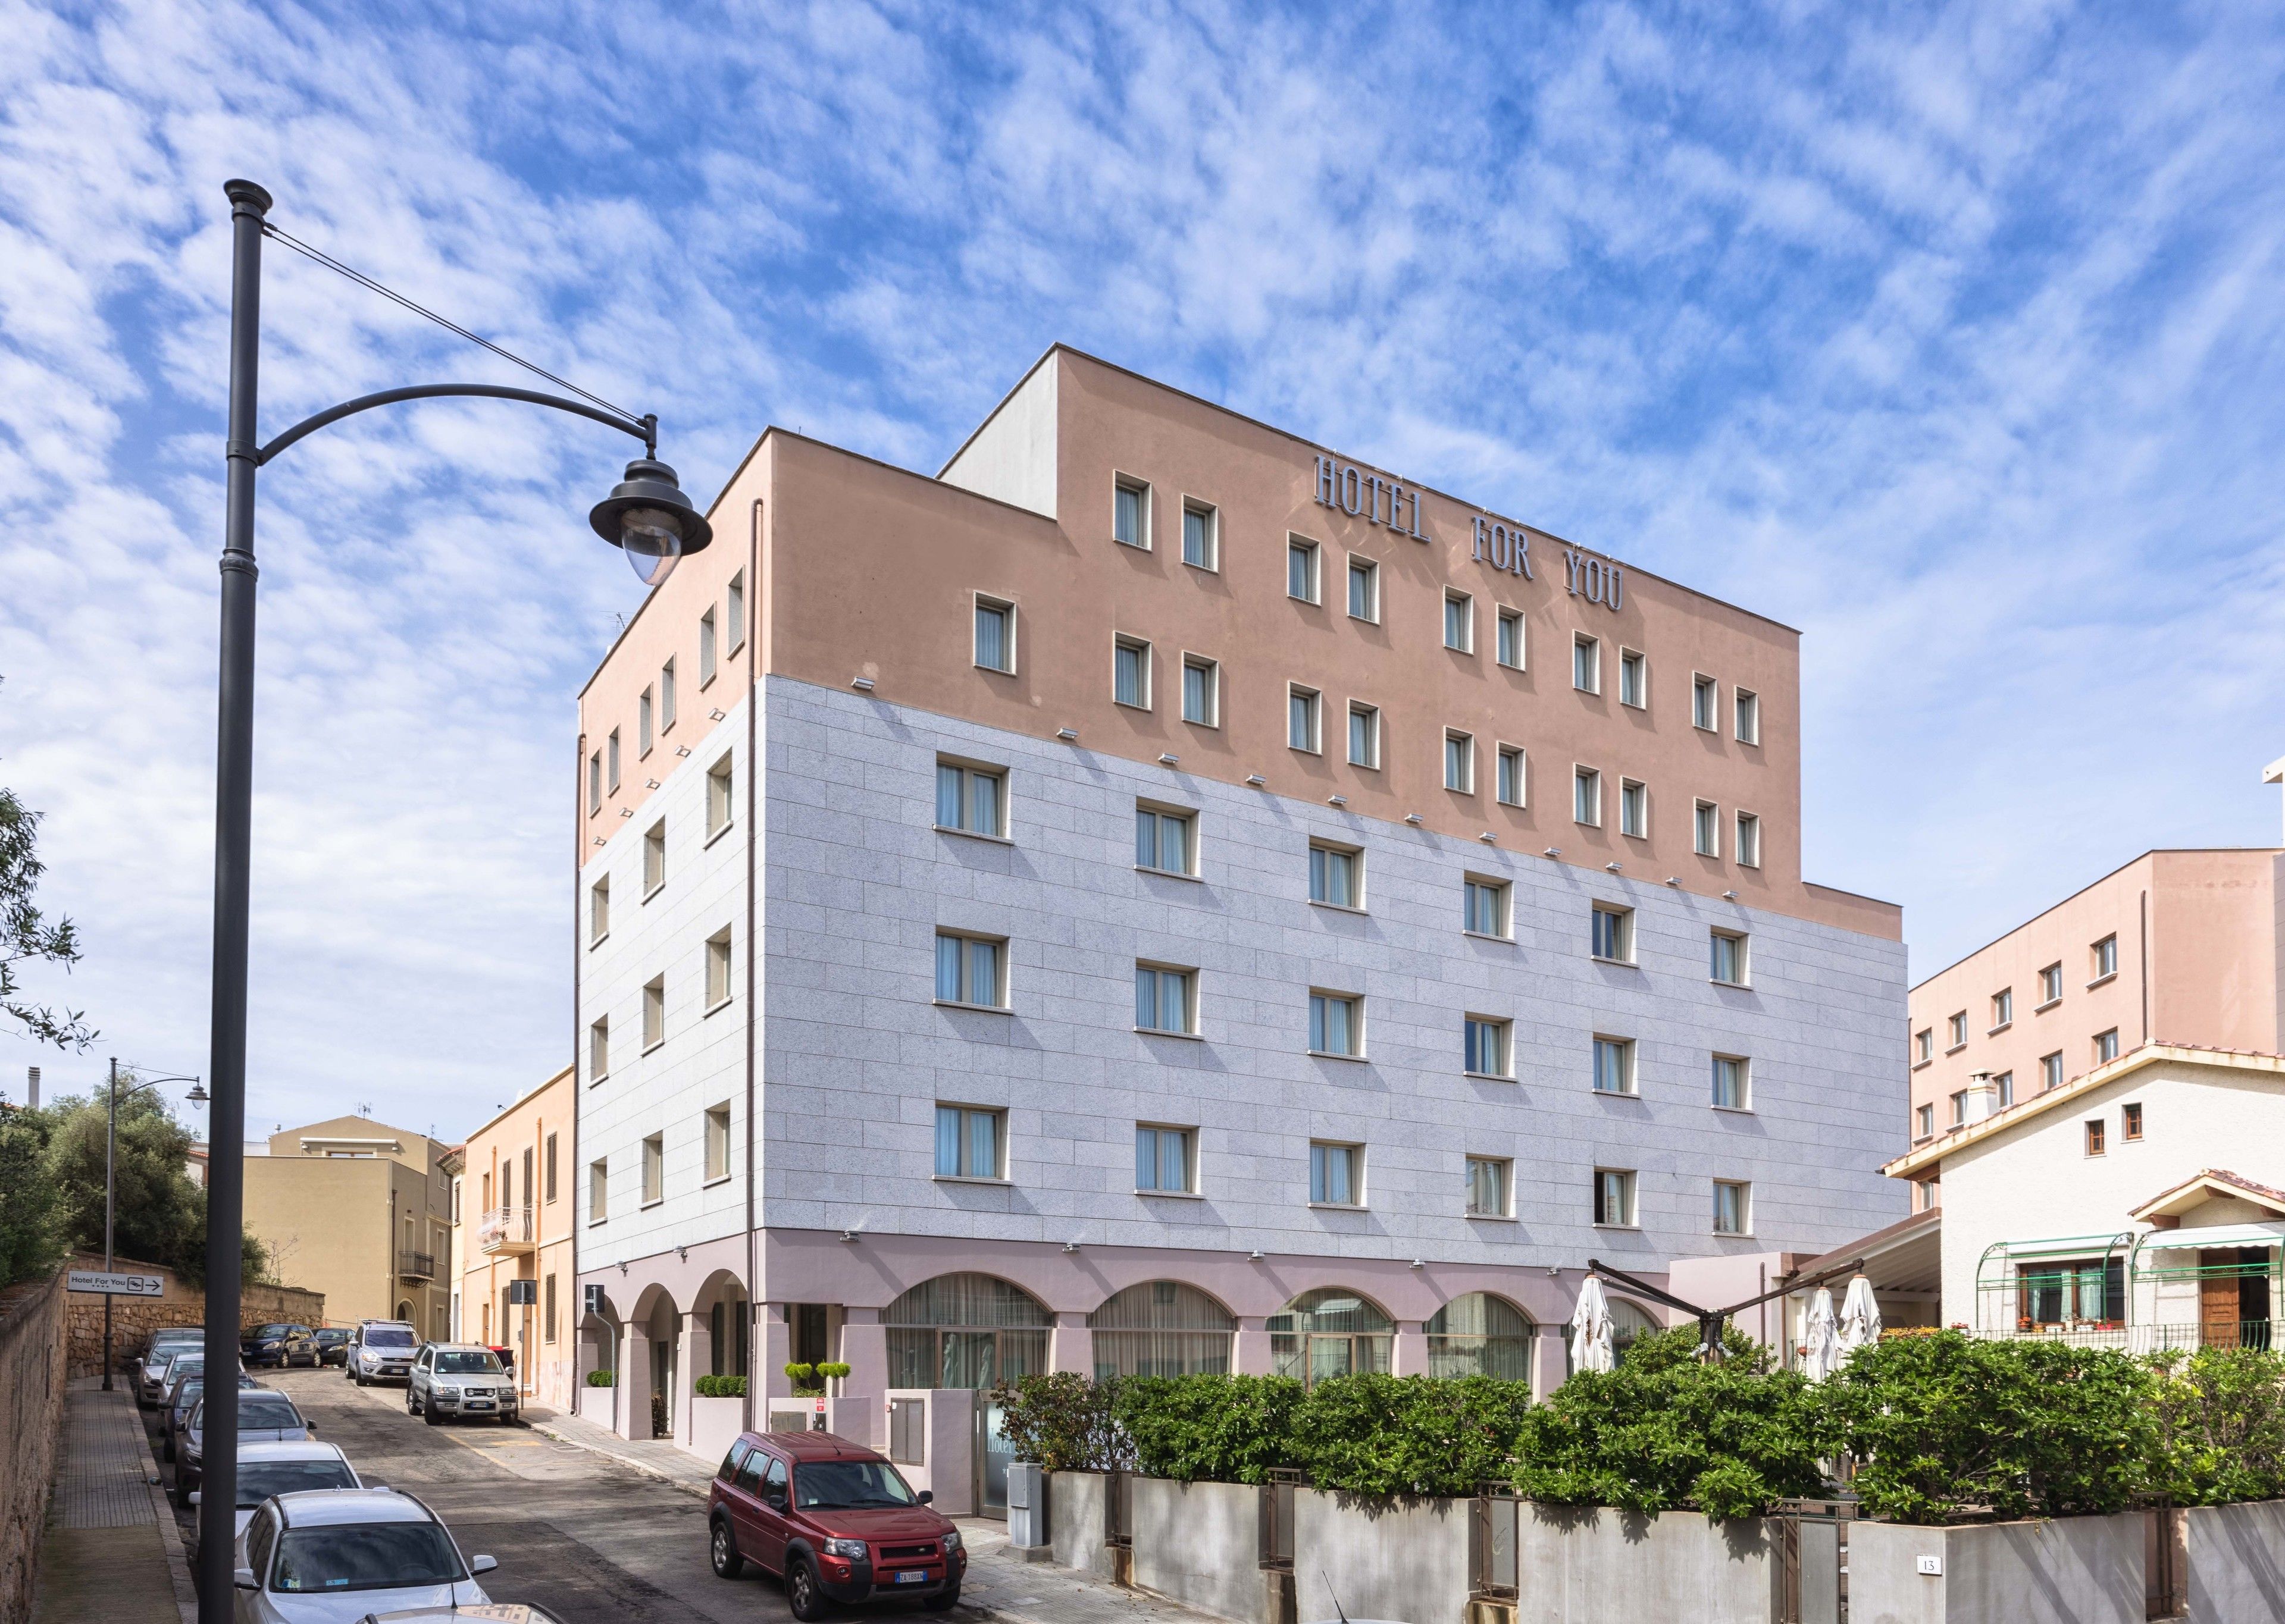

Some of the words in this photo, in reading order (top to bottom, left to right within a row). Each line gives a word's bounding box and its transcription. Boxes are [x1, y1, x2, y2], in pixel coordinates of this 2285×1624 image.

[1314, 454, 1431, 543] HOTEL
[1472, 516, 1533, 581] FOR
[1563, 548, 1623, 612] YOU
[1924, 1560, 1935, 1570] 13
